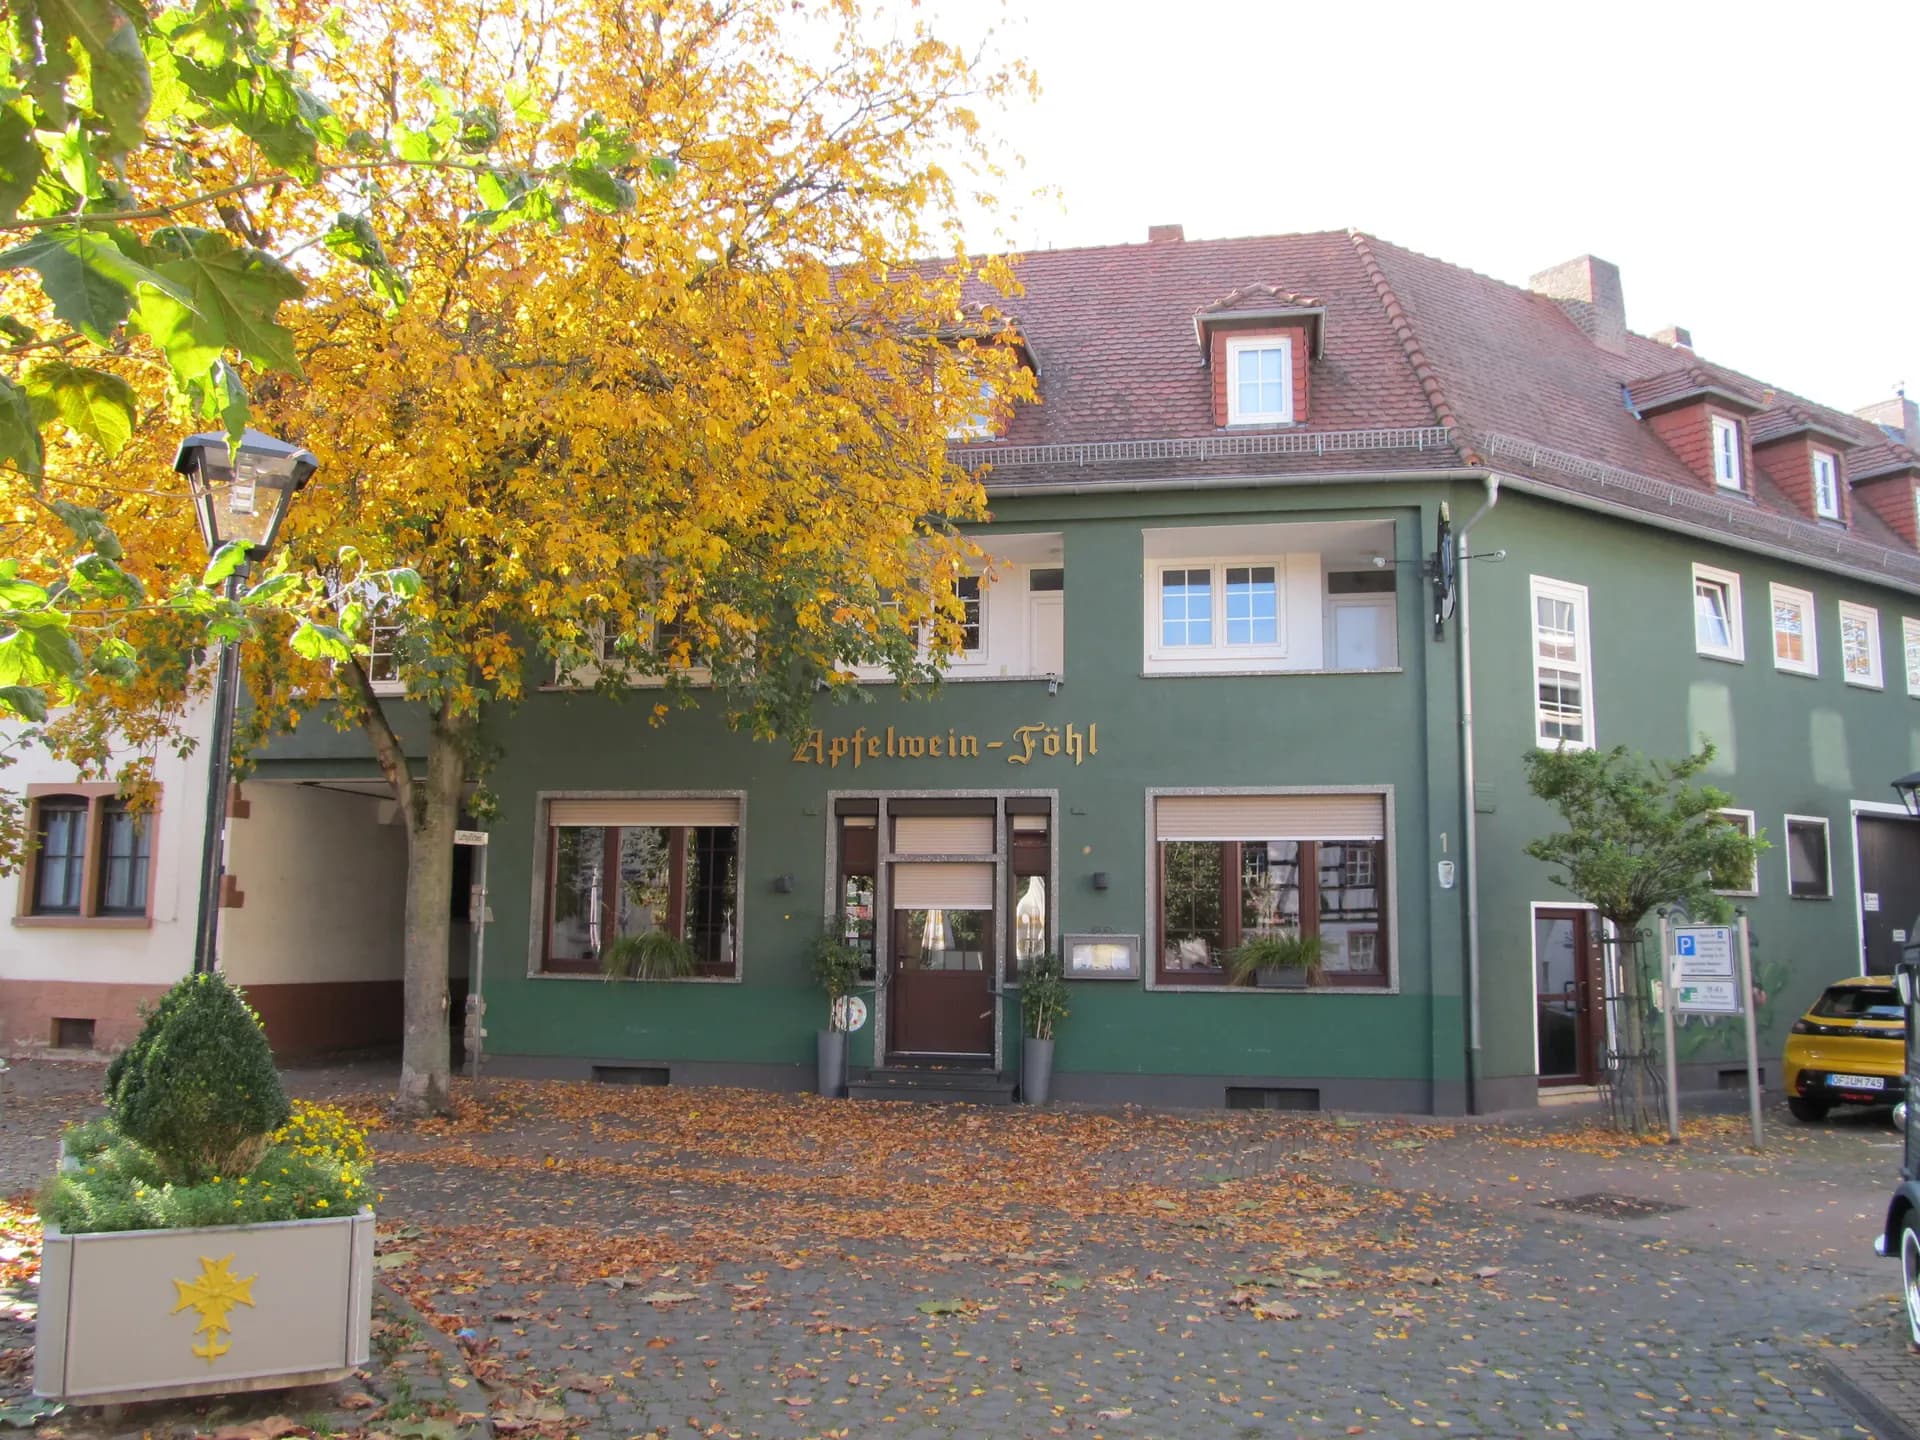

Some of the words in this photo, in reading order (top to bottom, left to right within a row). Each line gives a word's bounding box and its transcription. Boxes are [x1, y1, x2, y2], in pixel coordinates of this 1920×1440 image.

[792, 726, 979, 768] Apfelwein
[1007, 721, 1098, 766] Föhl
[1440, 832, 1447, 853] 1
[1680, 937, 1692, 954] P
